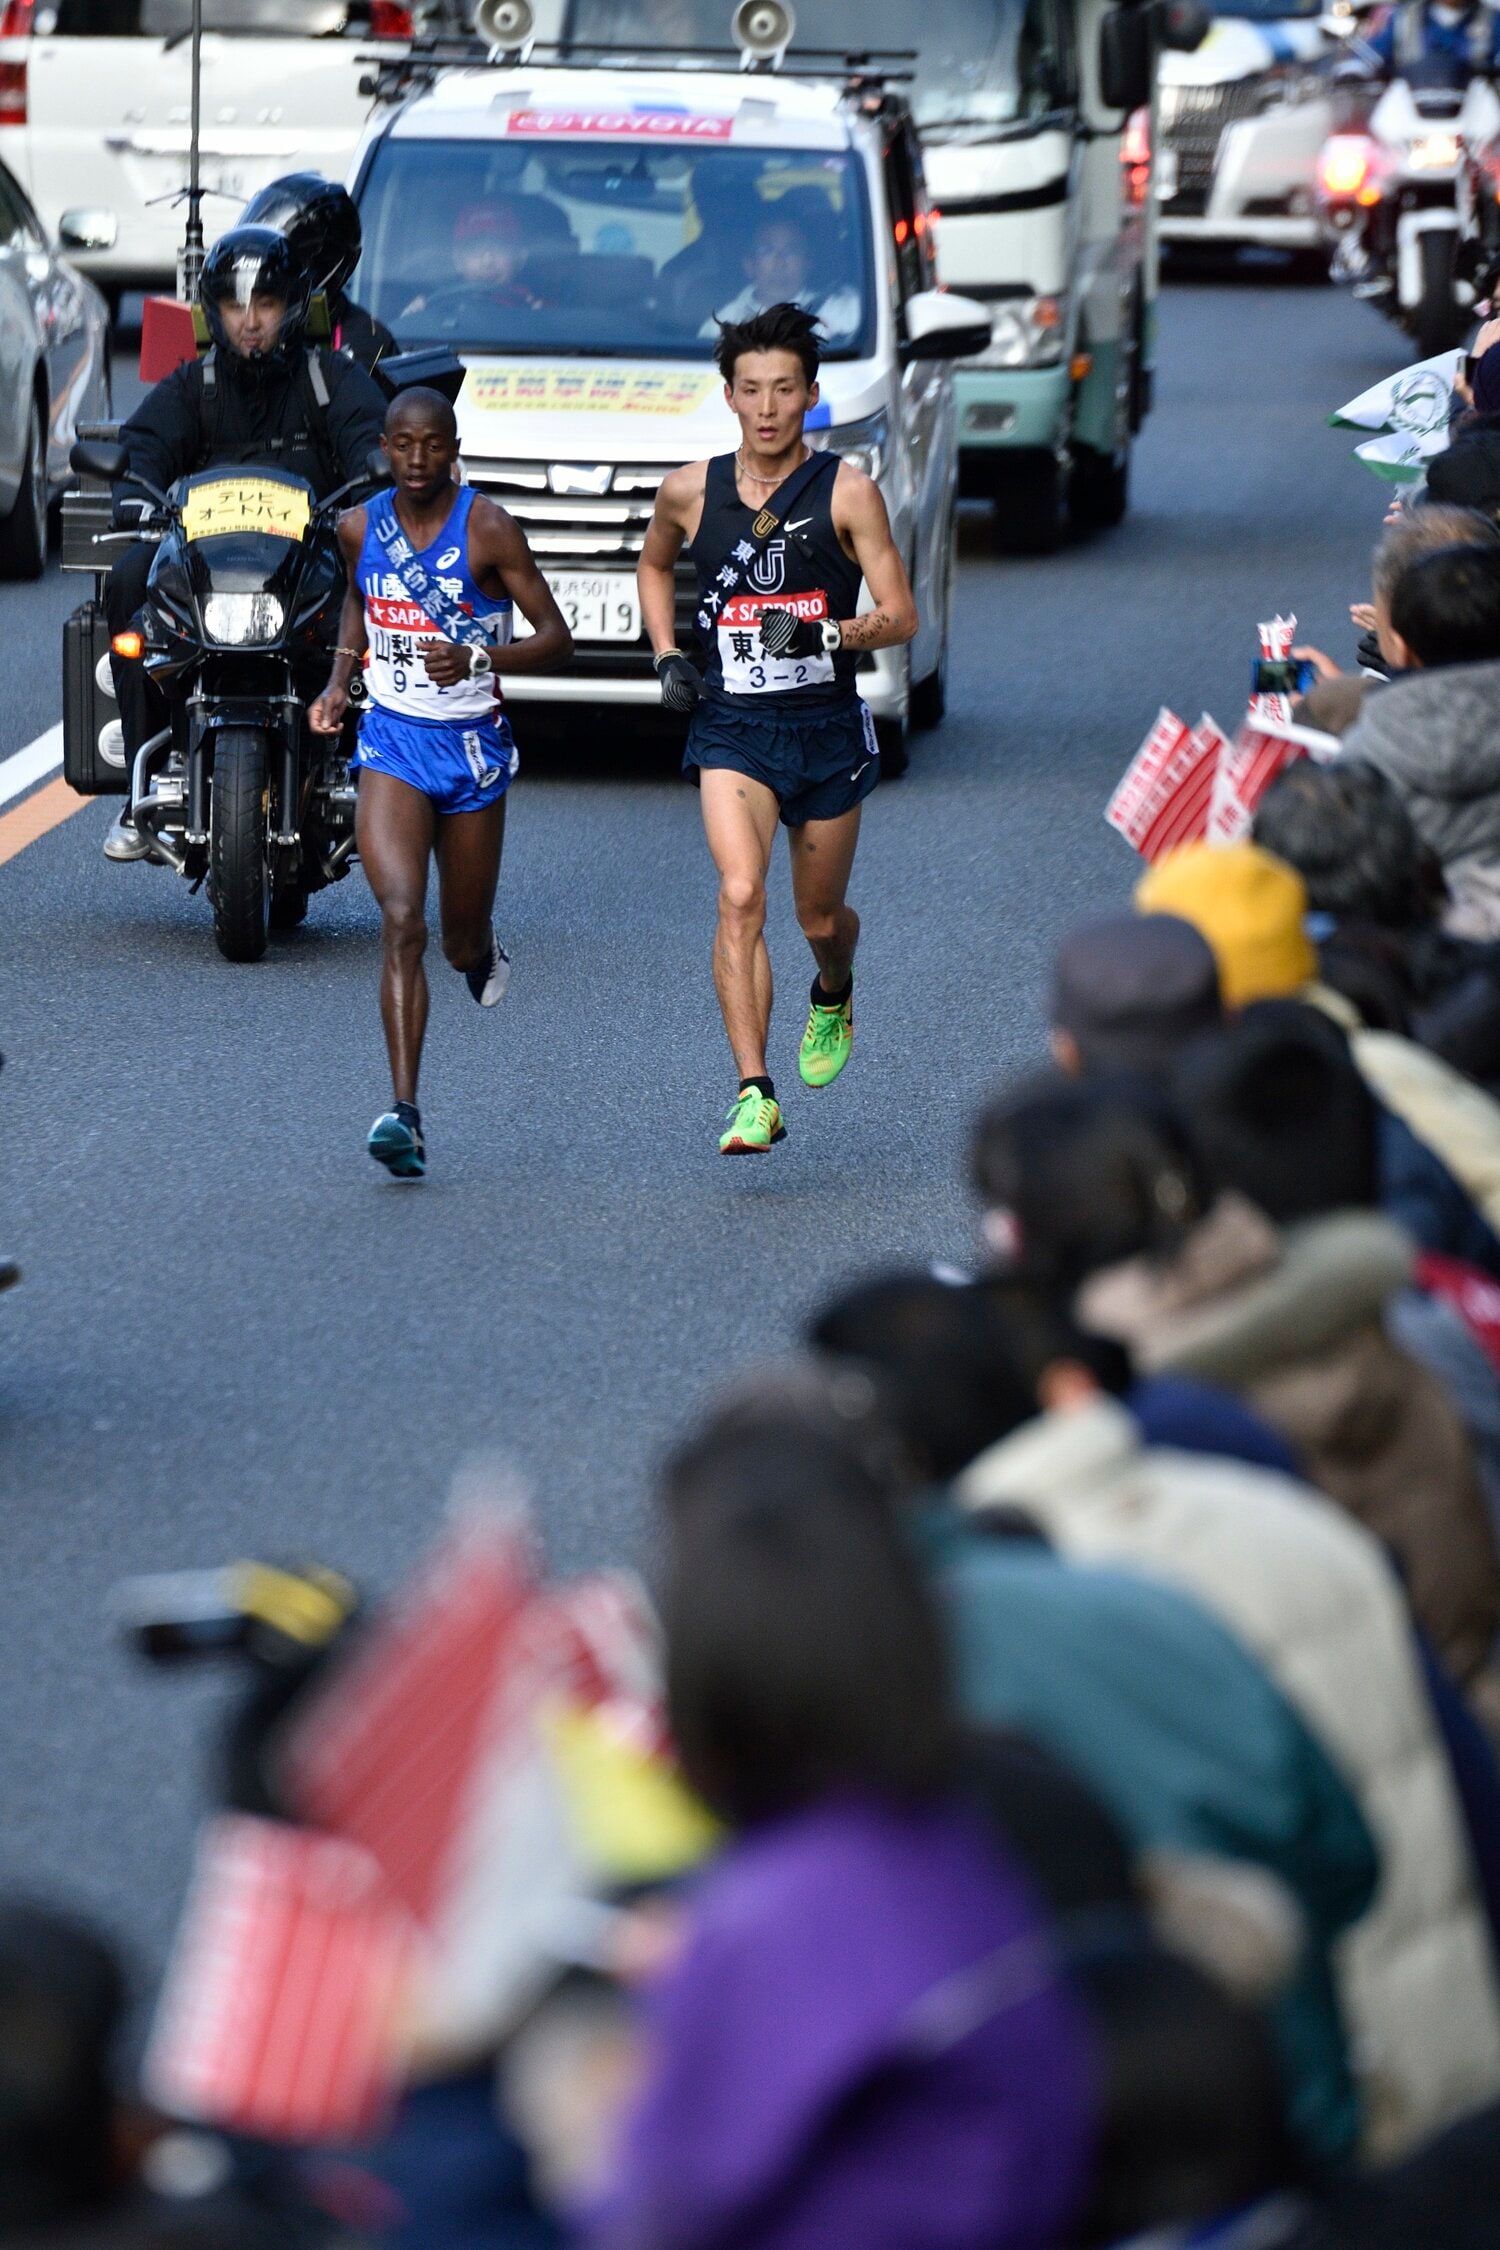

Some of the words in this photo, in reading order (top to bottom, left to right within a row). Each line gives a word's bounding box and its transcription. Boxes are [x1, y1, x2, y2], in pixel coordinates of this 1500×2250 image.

[218, 490, 274, 505] テレビ
[199, 504, 292, 521] オートバイ
[749, 664, 808, 689] 3-2
